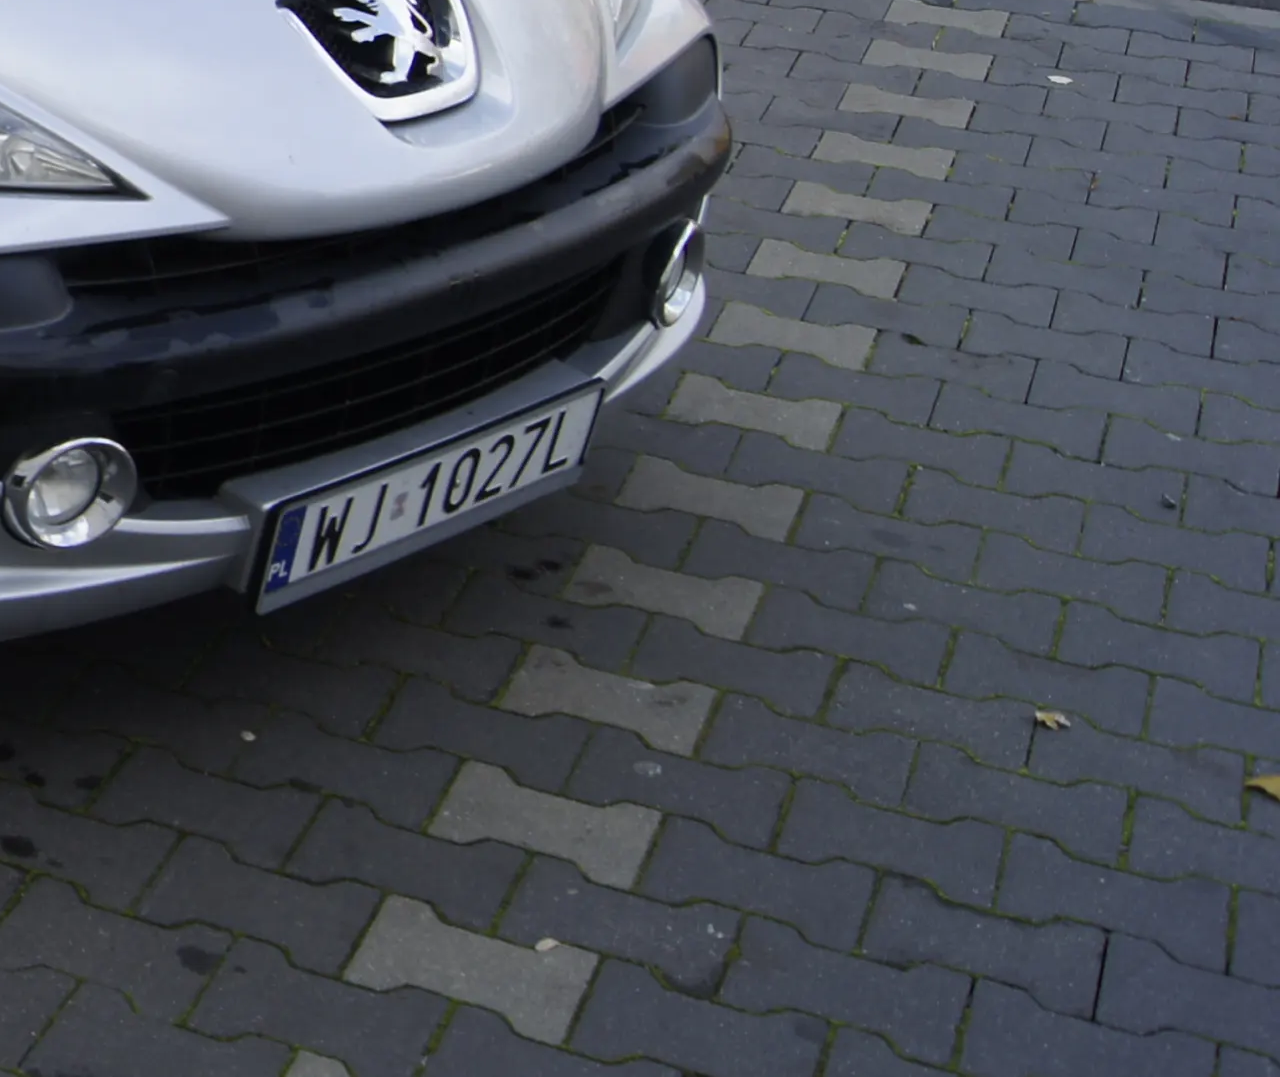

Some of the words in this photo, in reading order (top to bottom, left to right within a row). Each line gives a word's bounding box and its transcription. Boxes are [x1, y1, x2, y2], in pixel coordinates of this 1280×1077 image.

[307, 483, 388, 573] WJ
[417, 410, 567, 528] 1027L
[267, 560, 288, 582] PL
